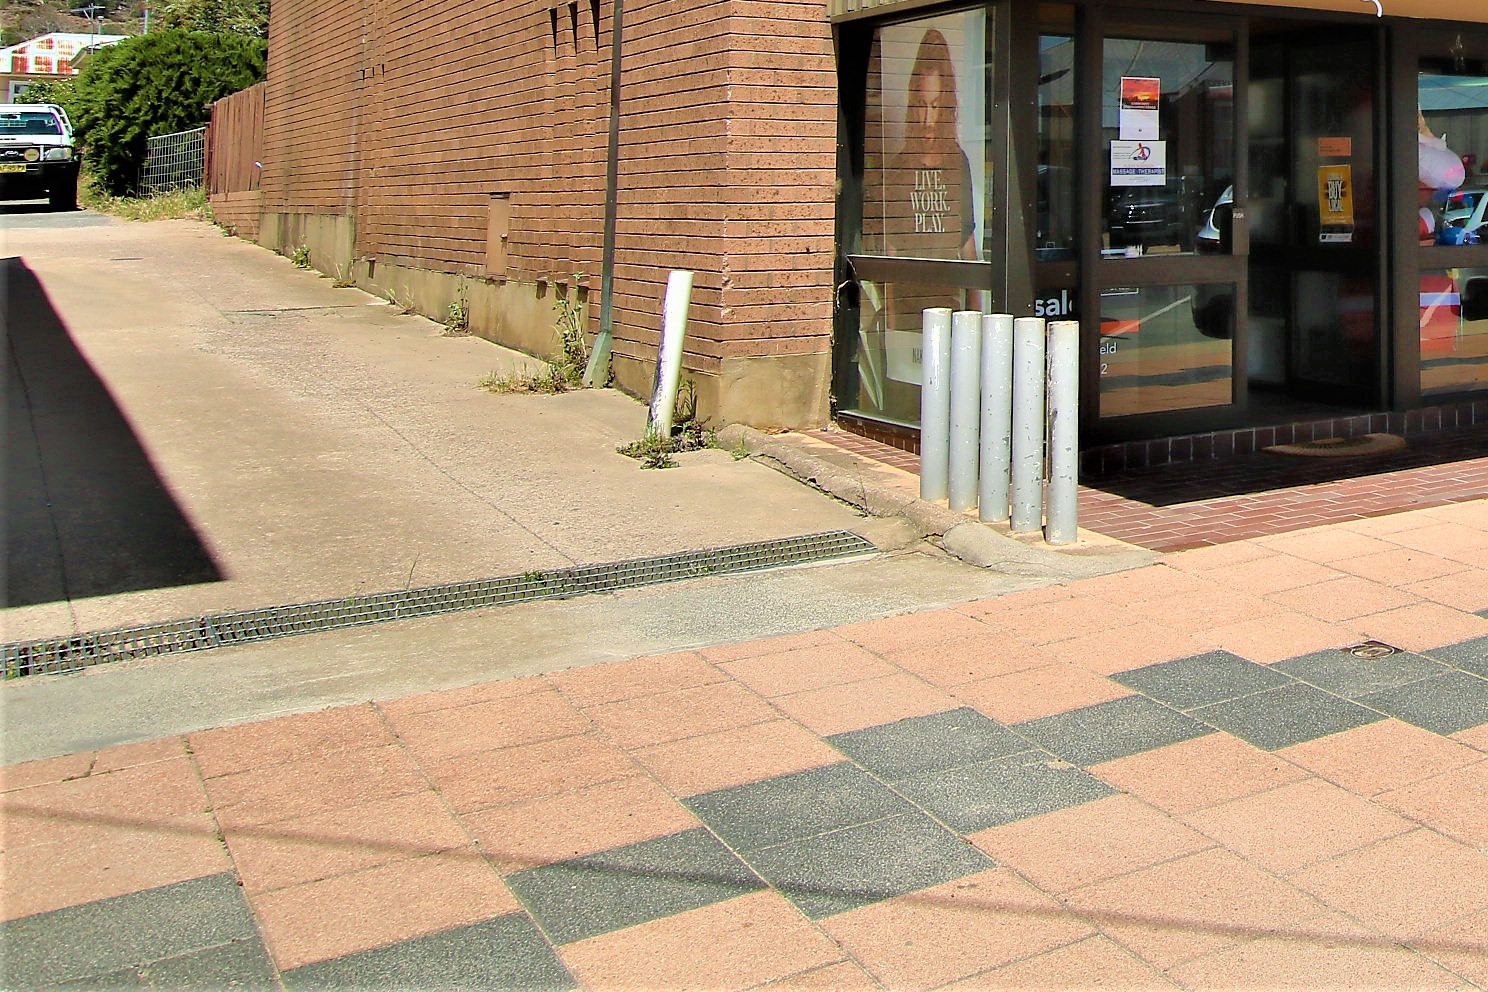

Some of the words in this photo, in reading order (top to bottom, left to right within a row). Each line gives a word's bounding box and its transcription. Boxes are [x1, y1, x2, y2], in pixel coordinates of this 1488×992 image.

[914, 169, 946, 190] LIVE.
[910, 191, 951, 212] WORK.
[914, 212, 945, 233] PLAY.
